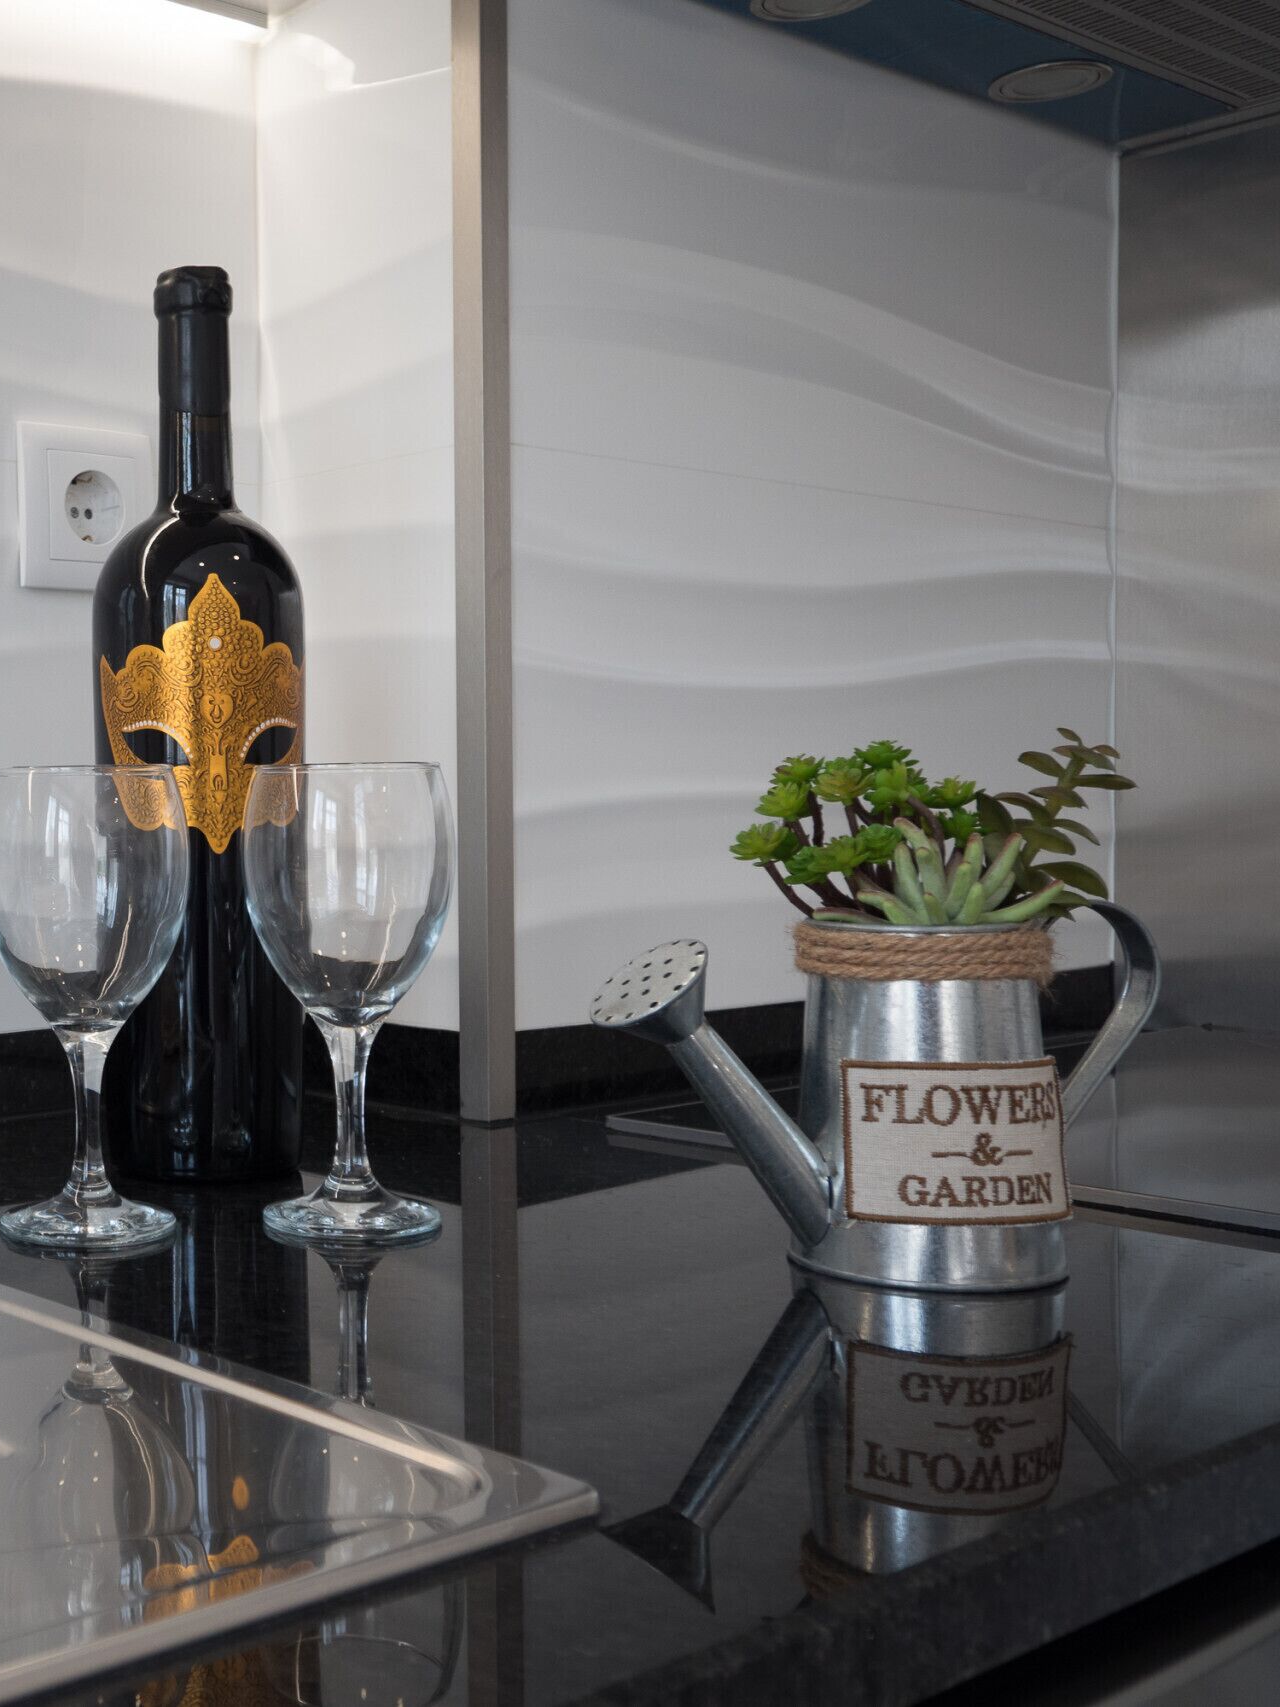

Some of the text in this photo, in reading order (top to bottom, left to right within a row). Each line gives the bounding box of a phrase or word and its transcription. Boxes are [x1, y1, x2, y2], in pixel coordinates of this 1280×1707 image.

[860, 1082, 1056, 1126] FLOWERS
[970, 1132, 1003, 1167] &
[897, 1173, 1053, 1208] GARDEN
